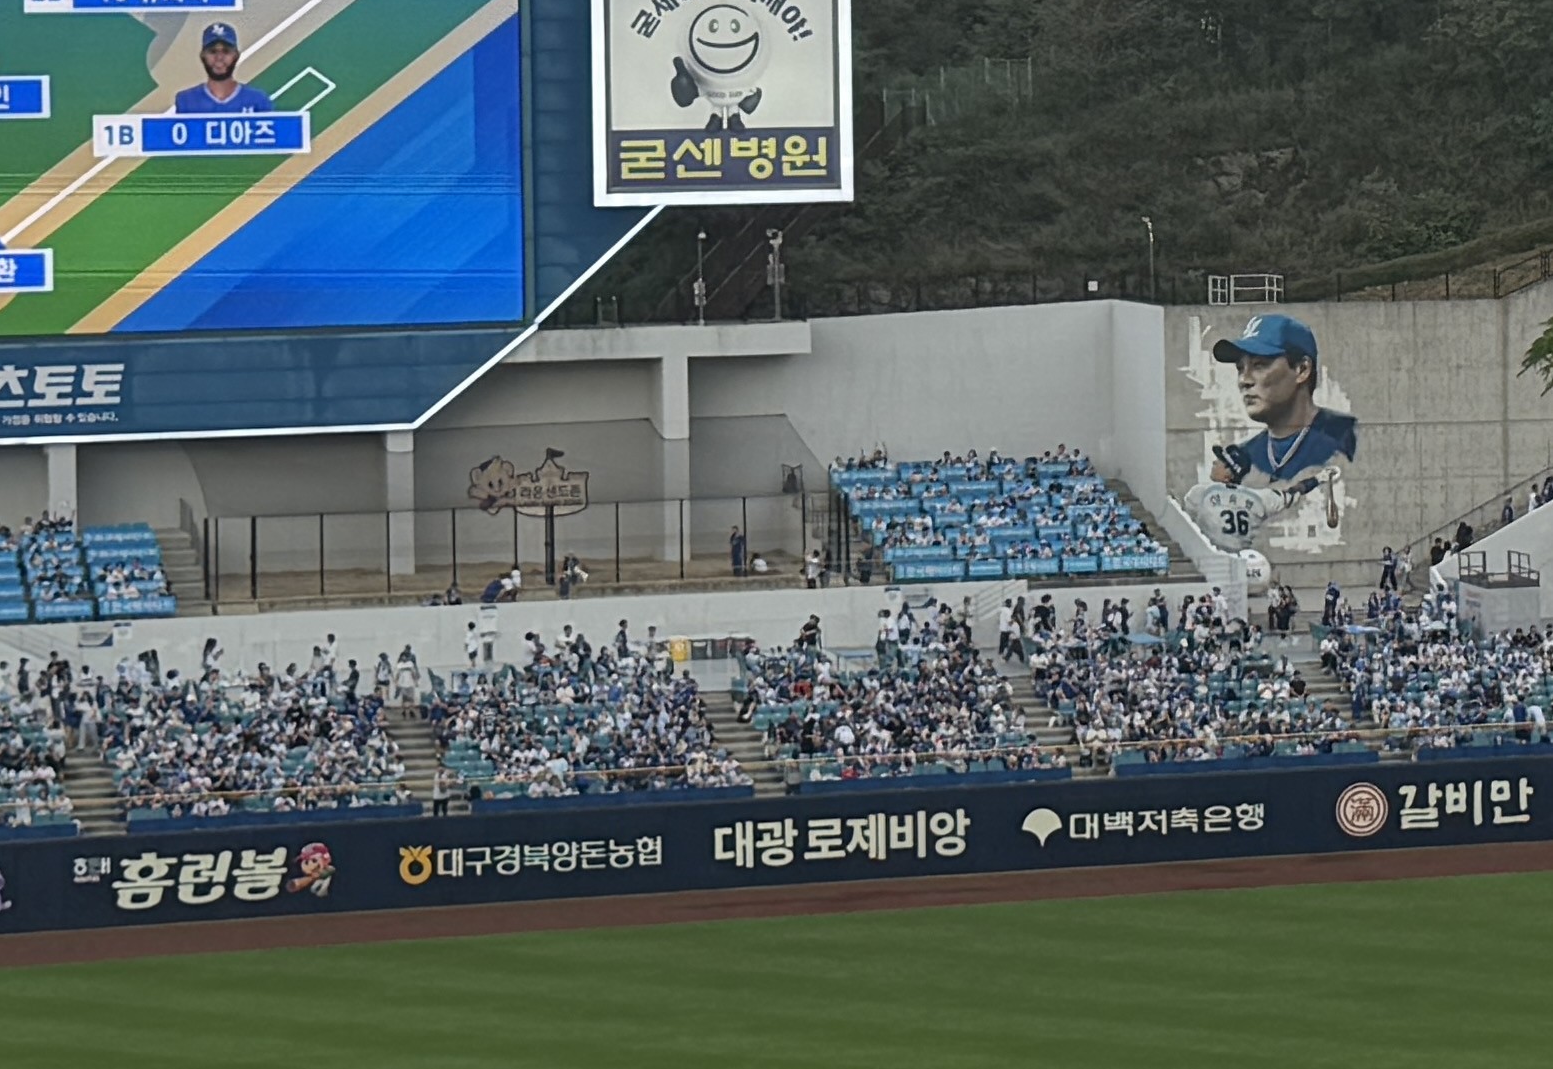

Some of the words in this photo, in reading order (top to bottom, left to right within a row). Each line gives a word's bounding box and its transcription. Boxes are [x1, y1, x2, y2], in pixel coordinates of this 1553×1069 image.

[104, 125, 135, 146] 1B
[171, 123, 187, 145] 0
[205, 118, 276, 146] 디아즈
[619, 135, 827, 180] 굳센병원
[1220, 509, 1249, 536] 36
[1069, 802, 1265, 840] 대백저축은행
[1398, 778, 1534, 830] 갈비만
[437, 836, 663, 877] 대구경북양돈농협
[111, 846, 288, 911] 홈런볼
